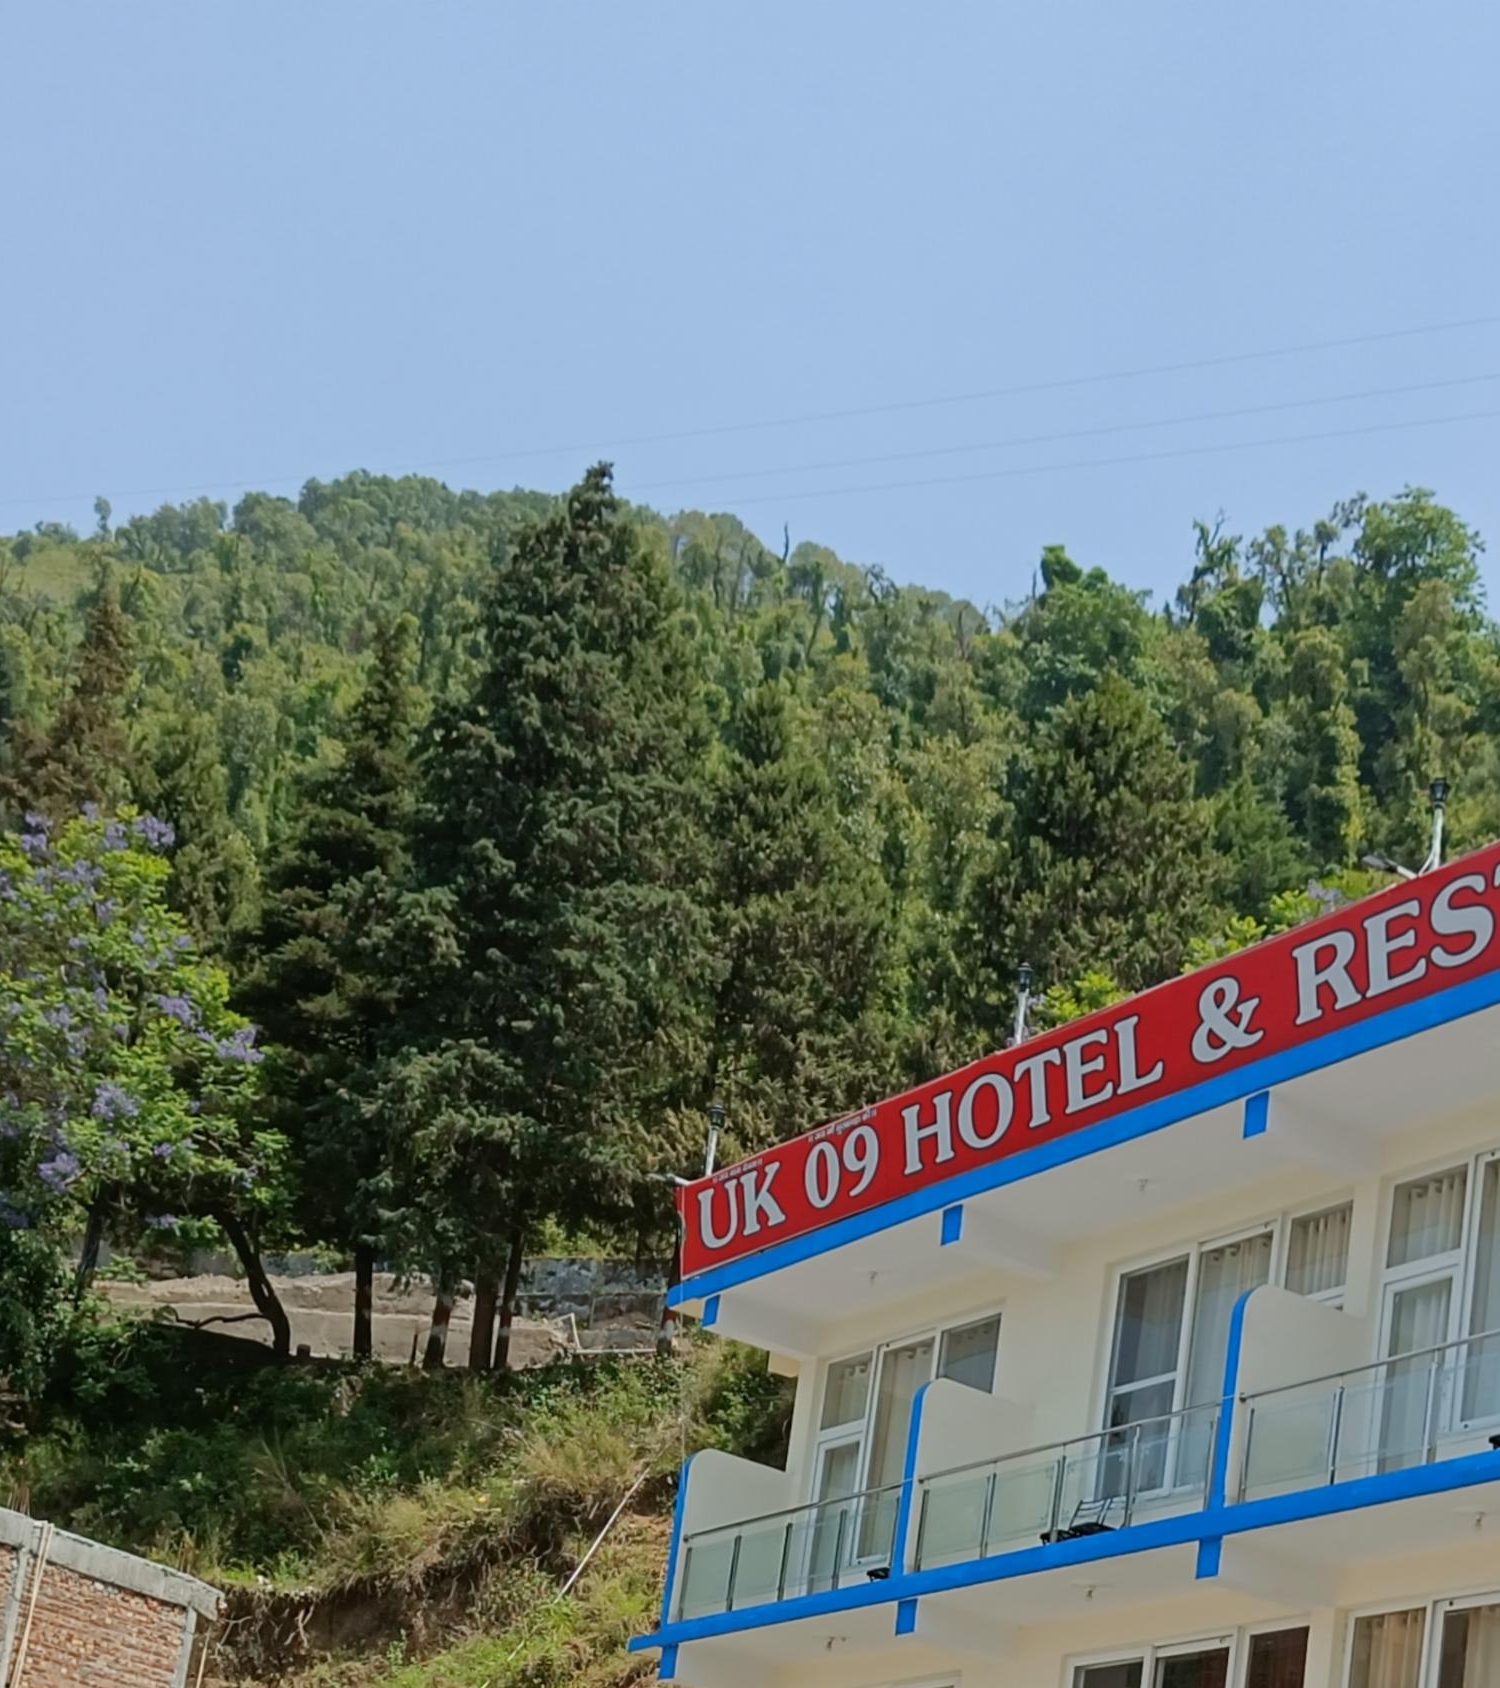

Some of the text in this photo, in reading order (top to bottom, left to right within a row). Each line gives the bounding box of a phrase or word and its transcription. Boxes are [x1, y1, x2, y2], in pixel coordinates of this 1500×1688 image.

[698, 1160, 787, 1250] UK
[803, 1124, 881, 1209] 09
[901, 1014, 1165, 1176] HOTEL
[1190, 976, 1265, 1064] &
